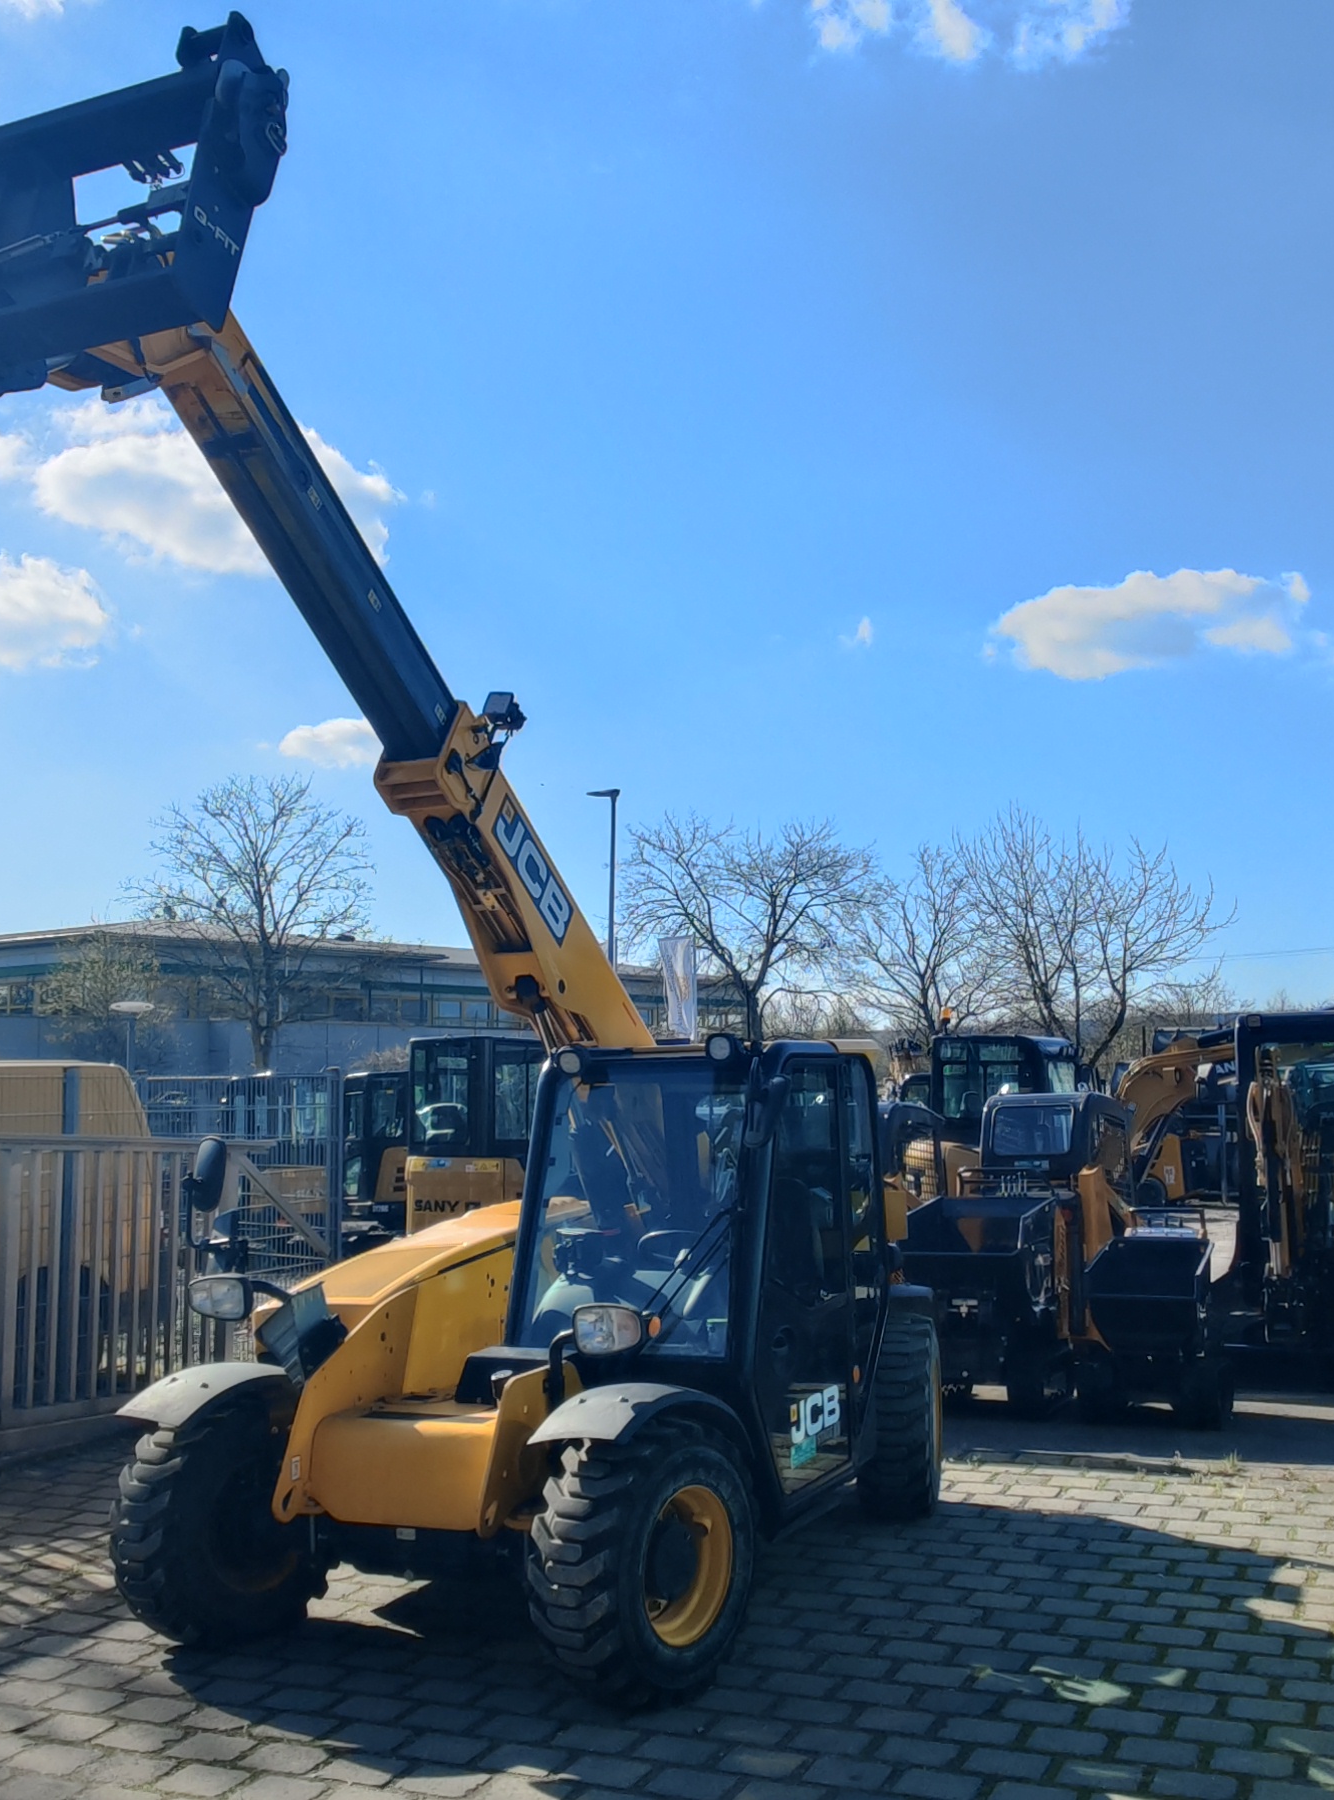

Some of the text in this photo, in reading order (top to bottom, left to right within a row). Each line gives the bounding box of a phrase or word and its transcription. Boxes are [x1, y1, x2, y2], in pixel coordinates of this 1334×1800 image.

[194, 205, 240, 256] Q-FIT
[496, 816, 570, 938] JCB
[414, 1200, 461, 1213] SANY
[789, 1385, 841, 1444] JCB
